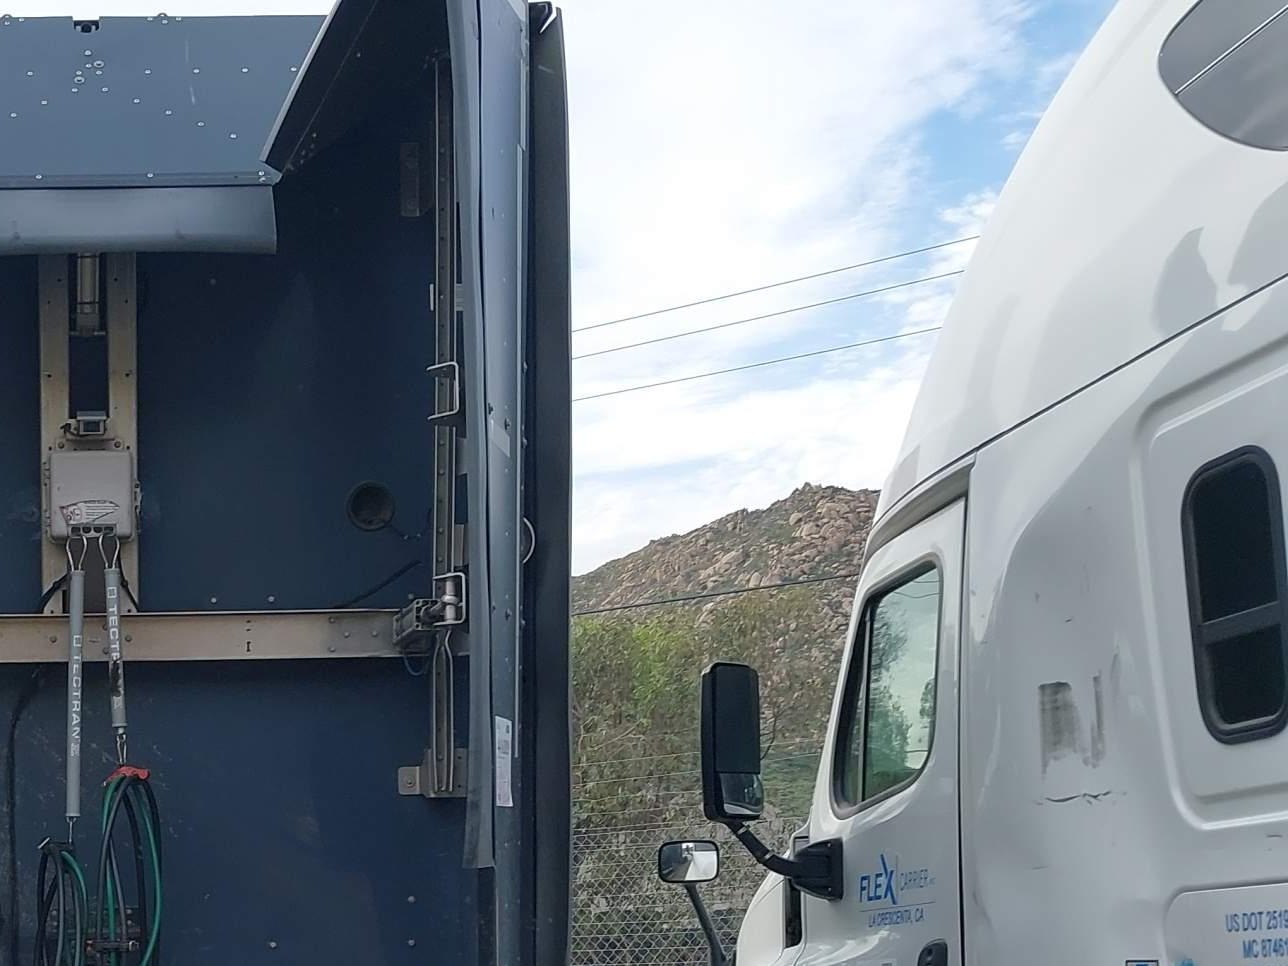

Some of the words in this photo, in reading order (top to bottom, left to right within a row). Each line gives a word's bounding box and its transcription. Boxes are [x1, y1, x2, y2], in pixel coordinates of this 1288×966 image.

[72, 655, 82, 739] TECTRAN
[859, 853, 896, 906] FLEX
[1225, 913, 1240, 932] US
[1242, 911, 1264, 931] DOT
[1242, 939, 1259, 959] MC
